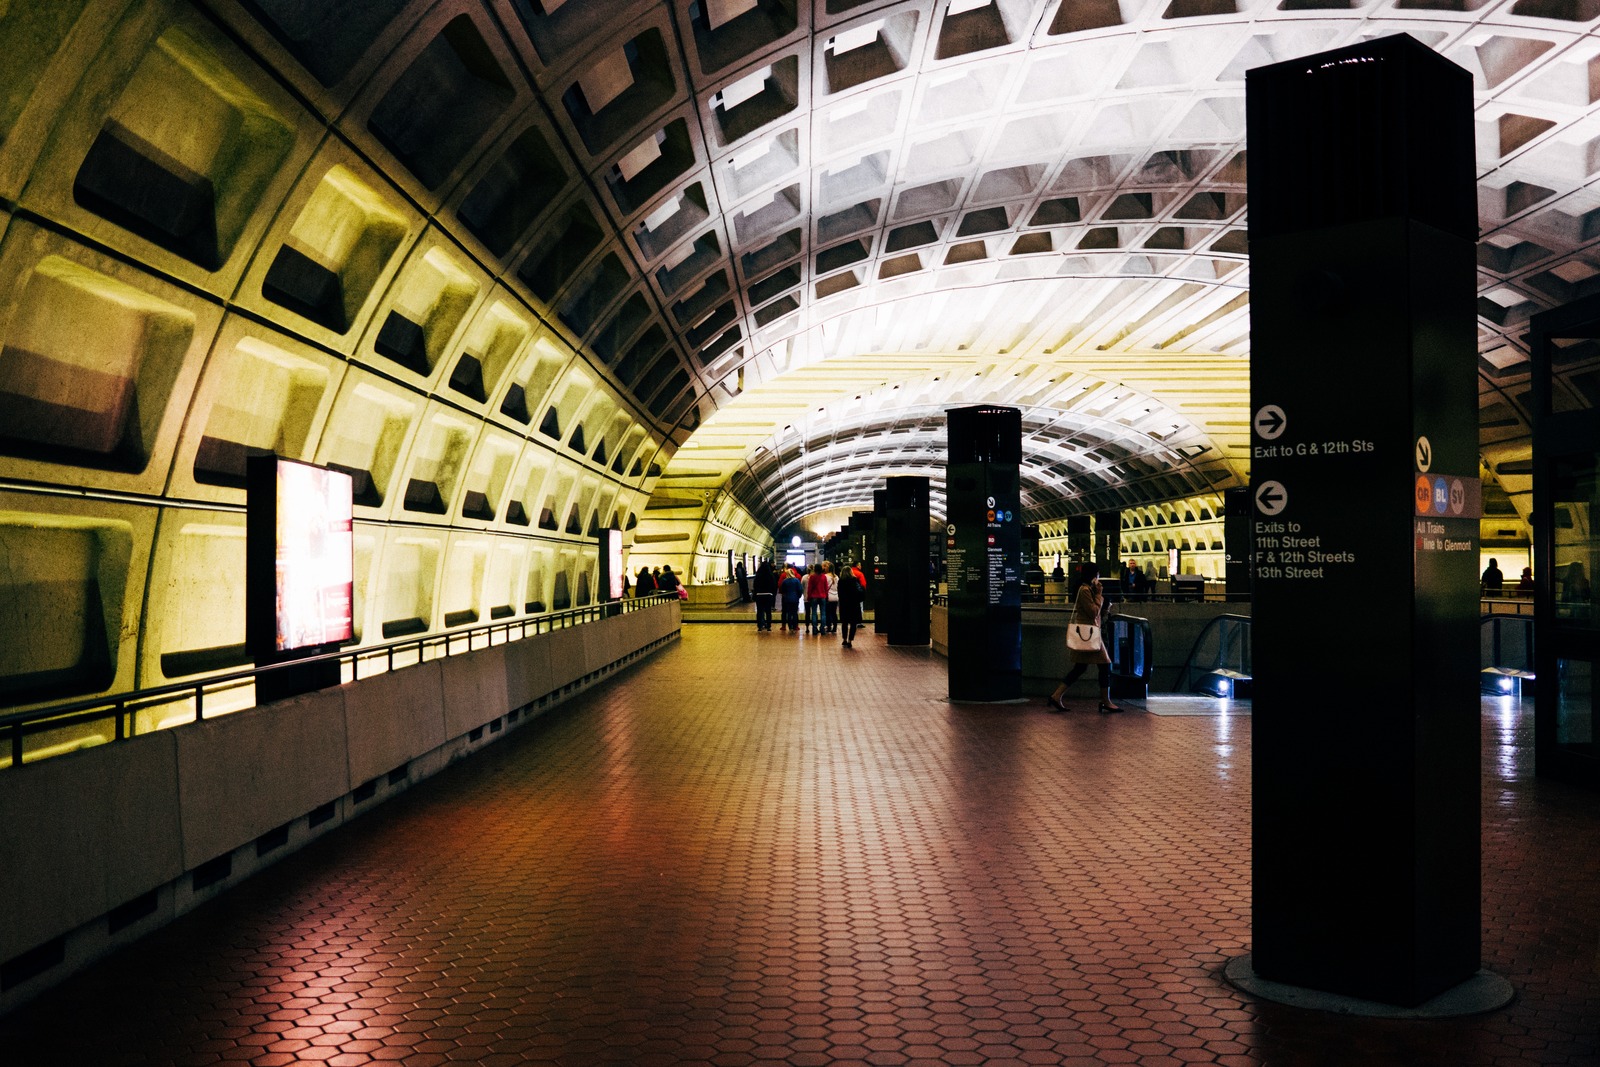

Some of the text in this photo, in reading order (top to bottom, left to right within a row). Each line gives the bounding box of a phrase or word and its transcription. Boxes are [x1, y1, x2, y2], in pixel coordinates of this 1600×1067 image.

[1254, 439, 1375, 458] Exit to G & 12th Sts
[1417, 486, 1463, 504] OR BL SV
[1255, 521, 1301, 534] Exits to
[1416, 521, 1445, 534] All Trains
[1255, 535, 1321, 548] 11th Street
[1423, 537, 1472, 551] line to Glenmont
[1255, 550, 1355, 563] F & 12th Streets
[1256, 566, 1324, 579] 13th Street
